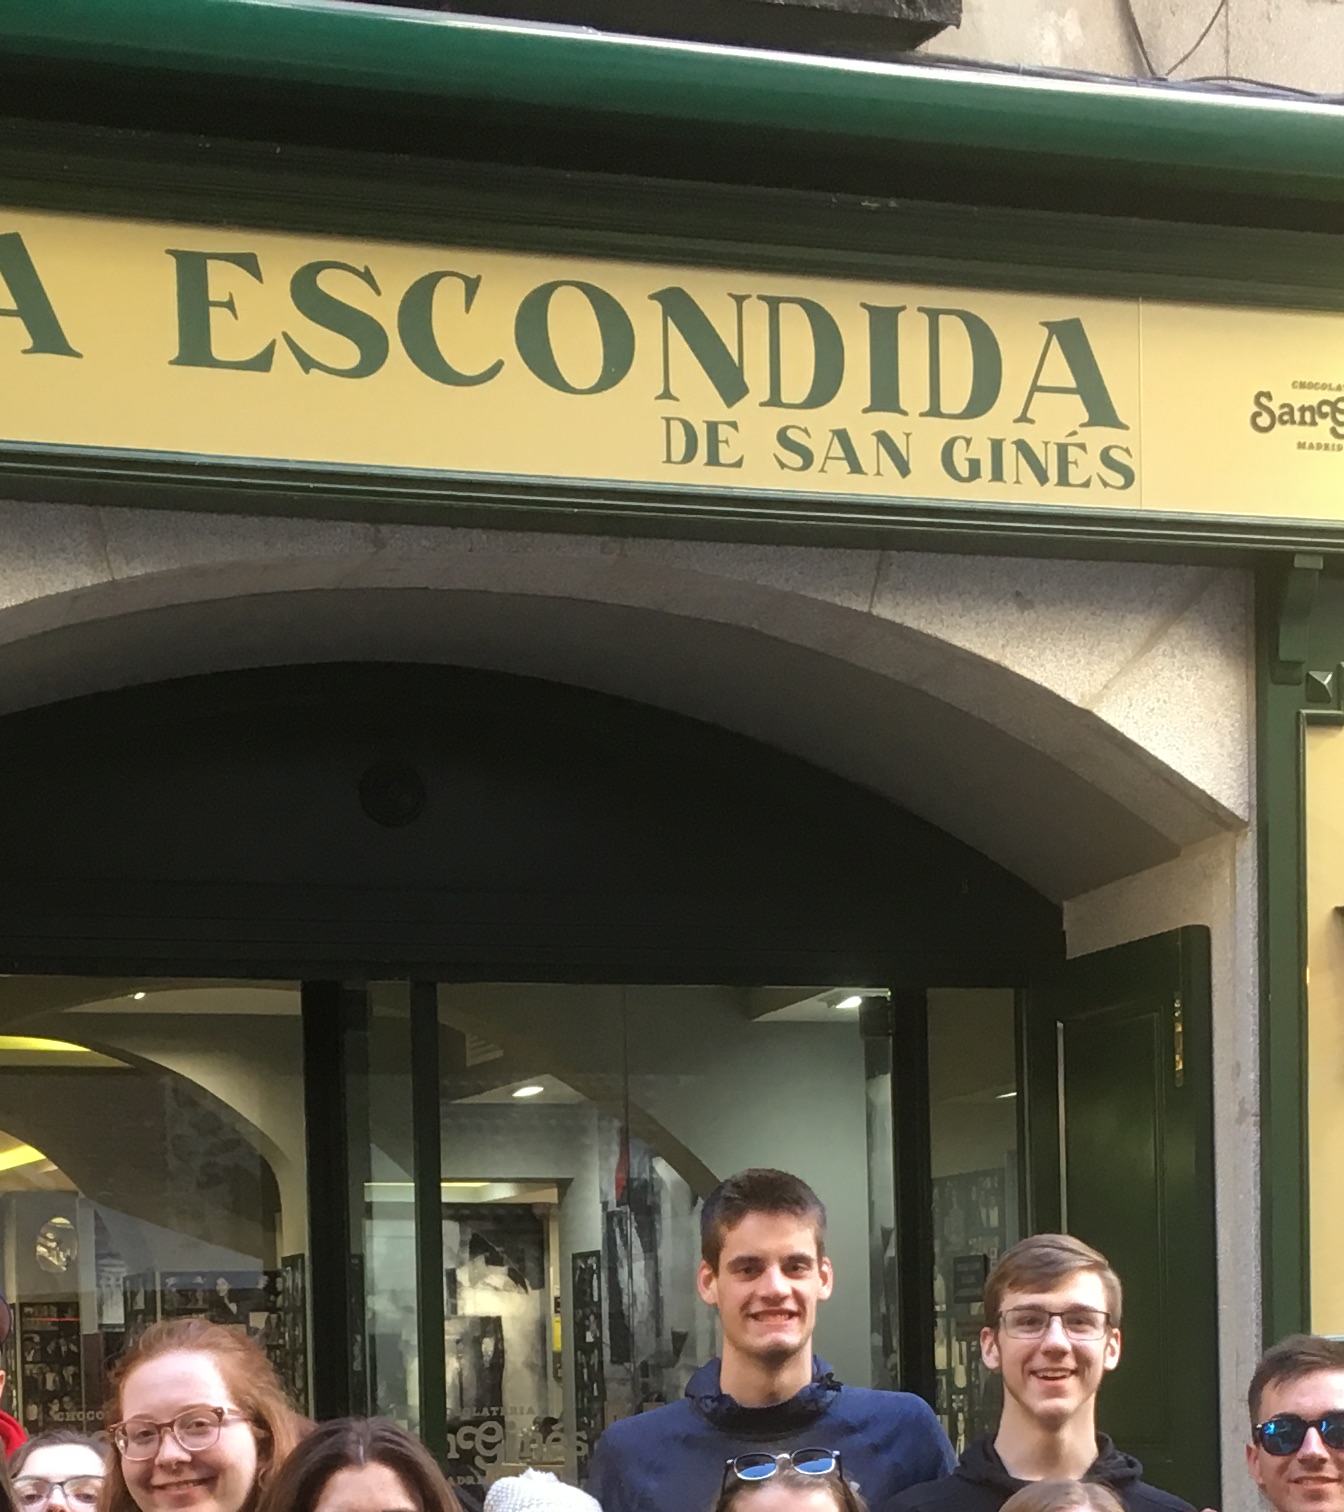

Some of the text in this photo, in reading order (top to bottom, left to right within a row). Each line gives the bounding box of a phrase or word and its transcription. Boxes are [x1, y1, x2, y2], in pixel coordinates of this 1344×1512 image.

[164, 248, 1129, 432] ESCONDIDA
[662, 416, 1135, 490] DE SAN GINÉS
[1296, 441, 1344, 452] MADRID
